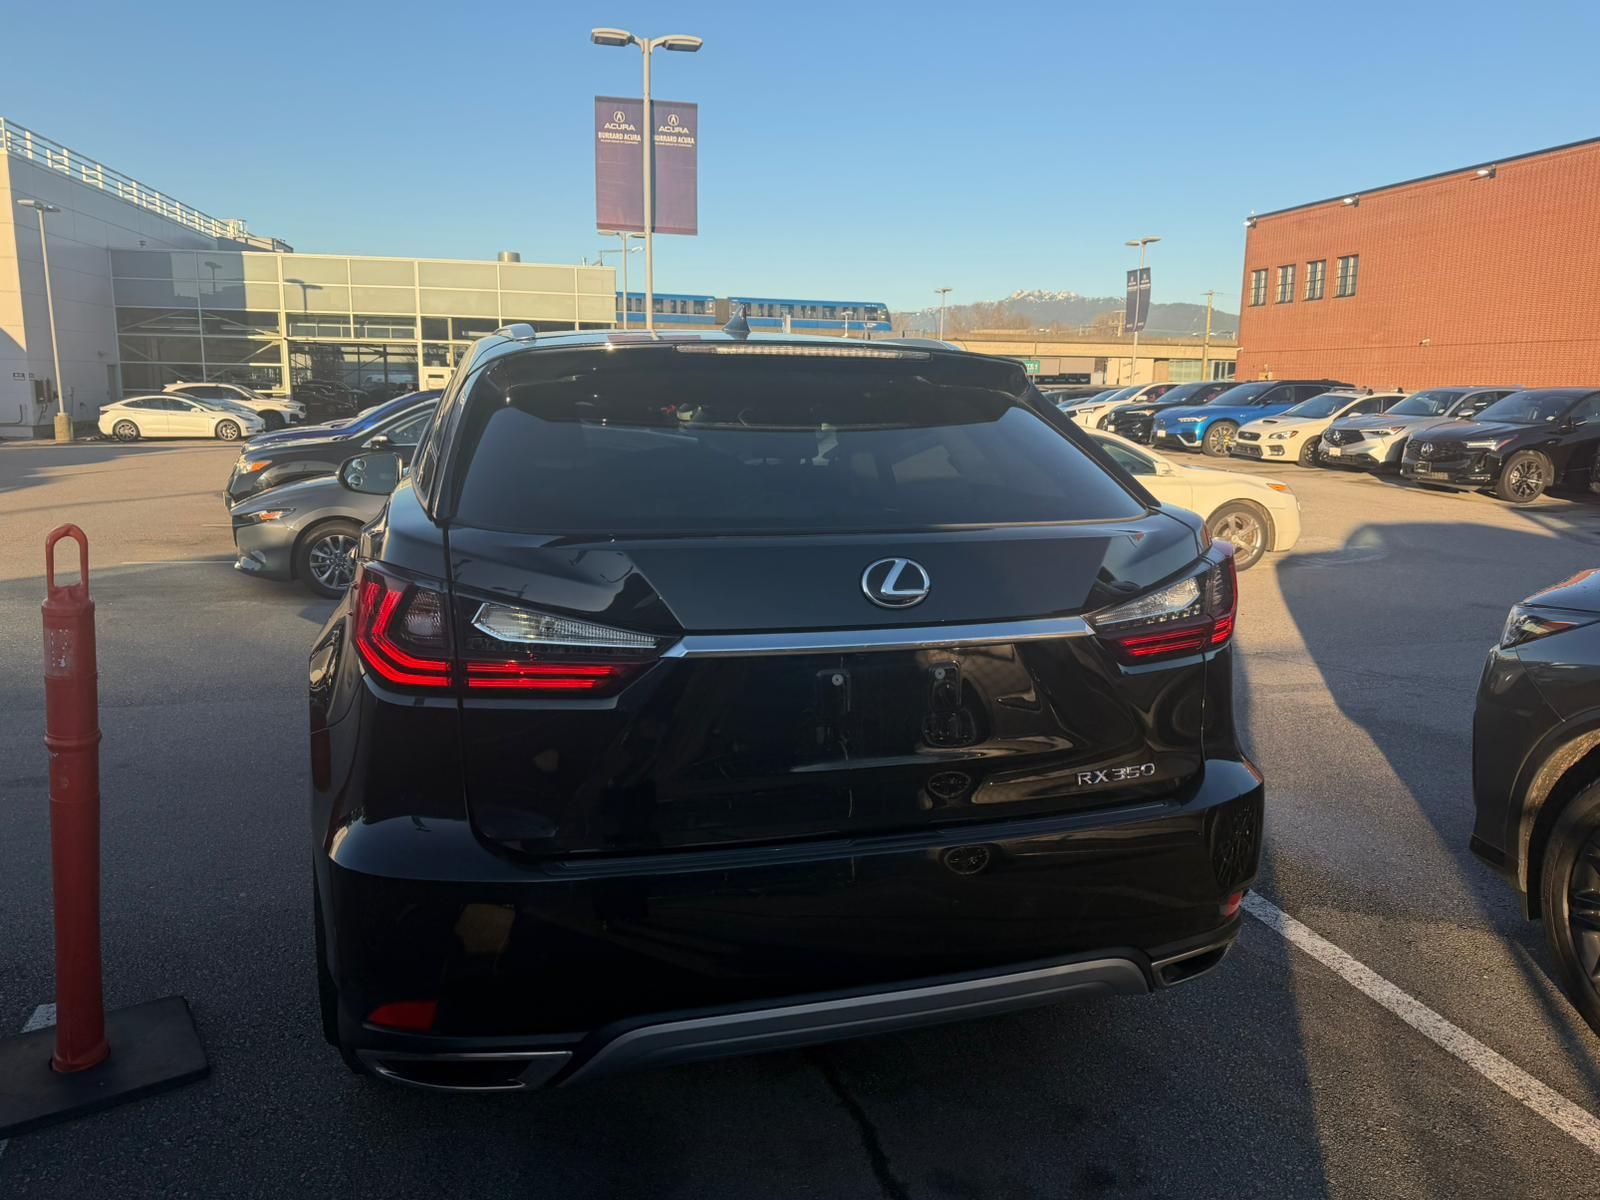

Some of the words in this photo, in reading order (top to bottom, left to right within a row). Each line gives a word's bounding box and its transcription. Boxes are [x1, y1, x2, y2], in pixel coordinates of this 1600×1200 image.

[604, 122, 635, 131] ACURA
[658, 126, 689, 134] ACURA
[678, 136, 695, 144] ACURA
[1077, 769, 1109, 785] RX
[1111, 763, 1155, 781] 350
